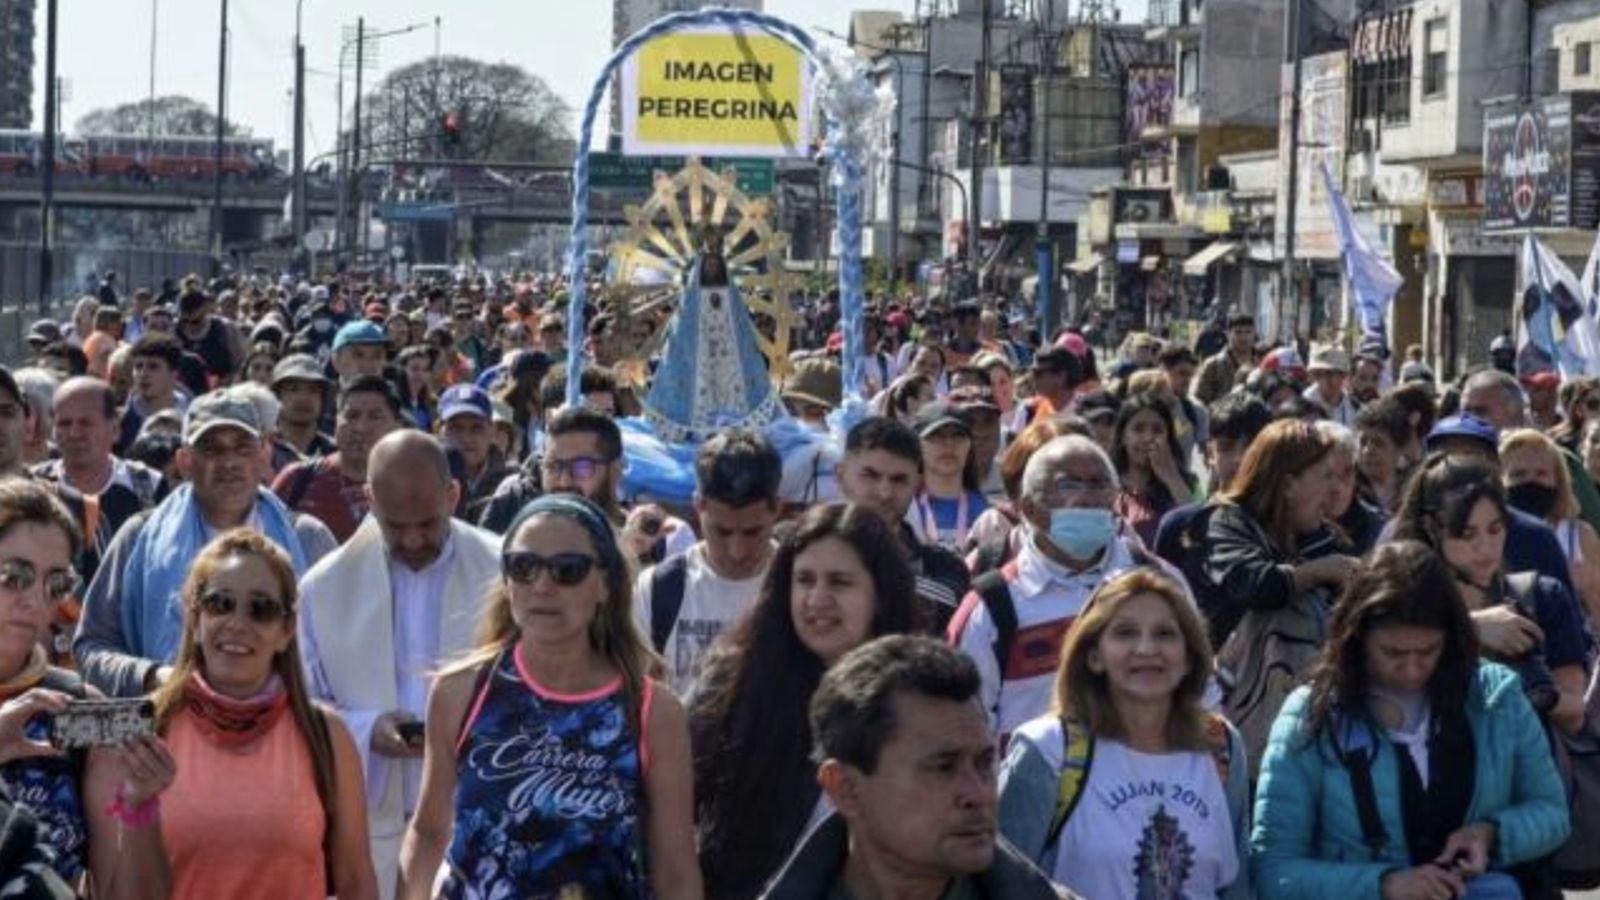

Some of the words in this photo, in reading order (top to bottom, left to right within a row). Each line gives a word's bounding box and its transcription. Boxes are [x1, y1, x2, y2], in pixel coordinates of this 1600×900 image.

[664, 60, 773, 83] IMAGEN
[638, 97, 798, 121] PEREGRINA
[469, 734, 607, 769] Carrera
[478, 766, 628, 819] Mujer
